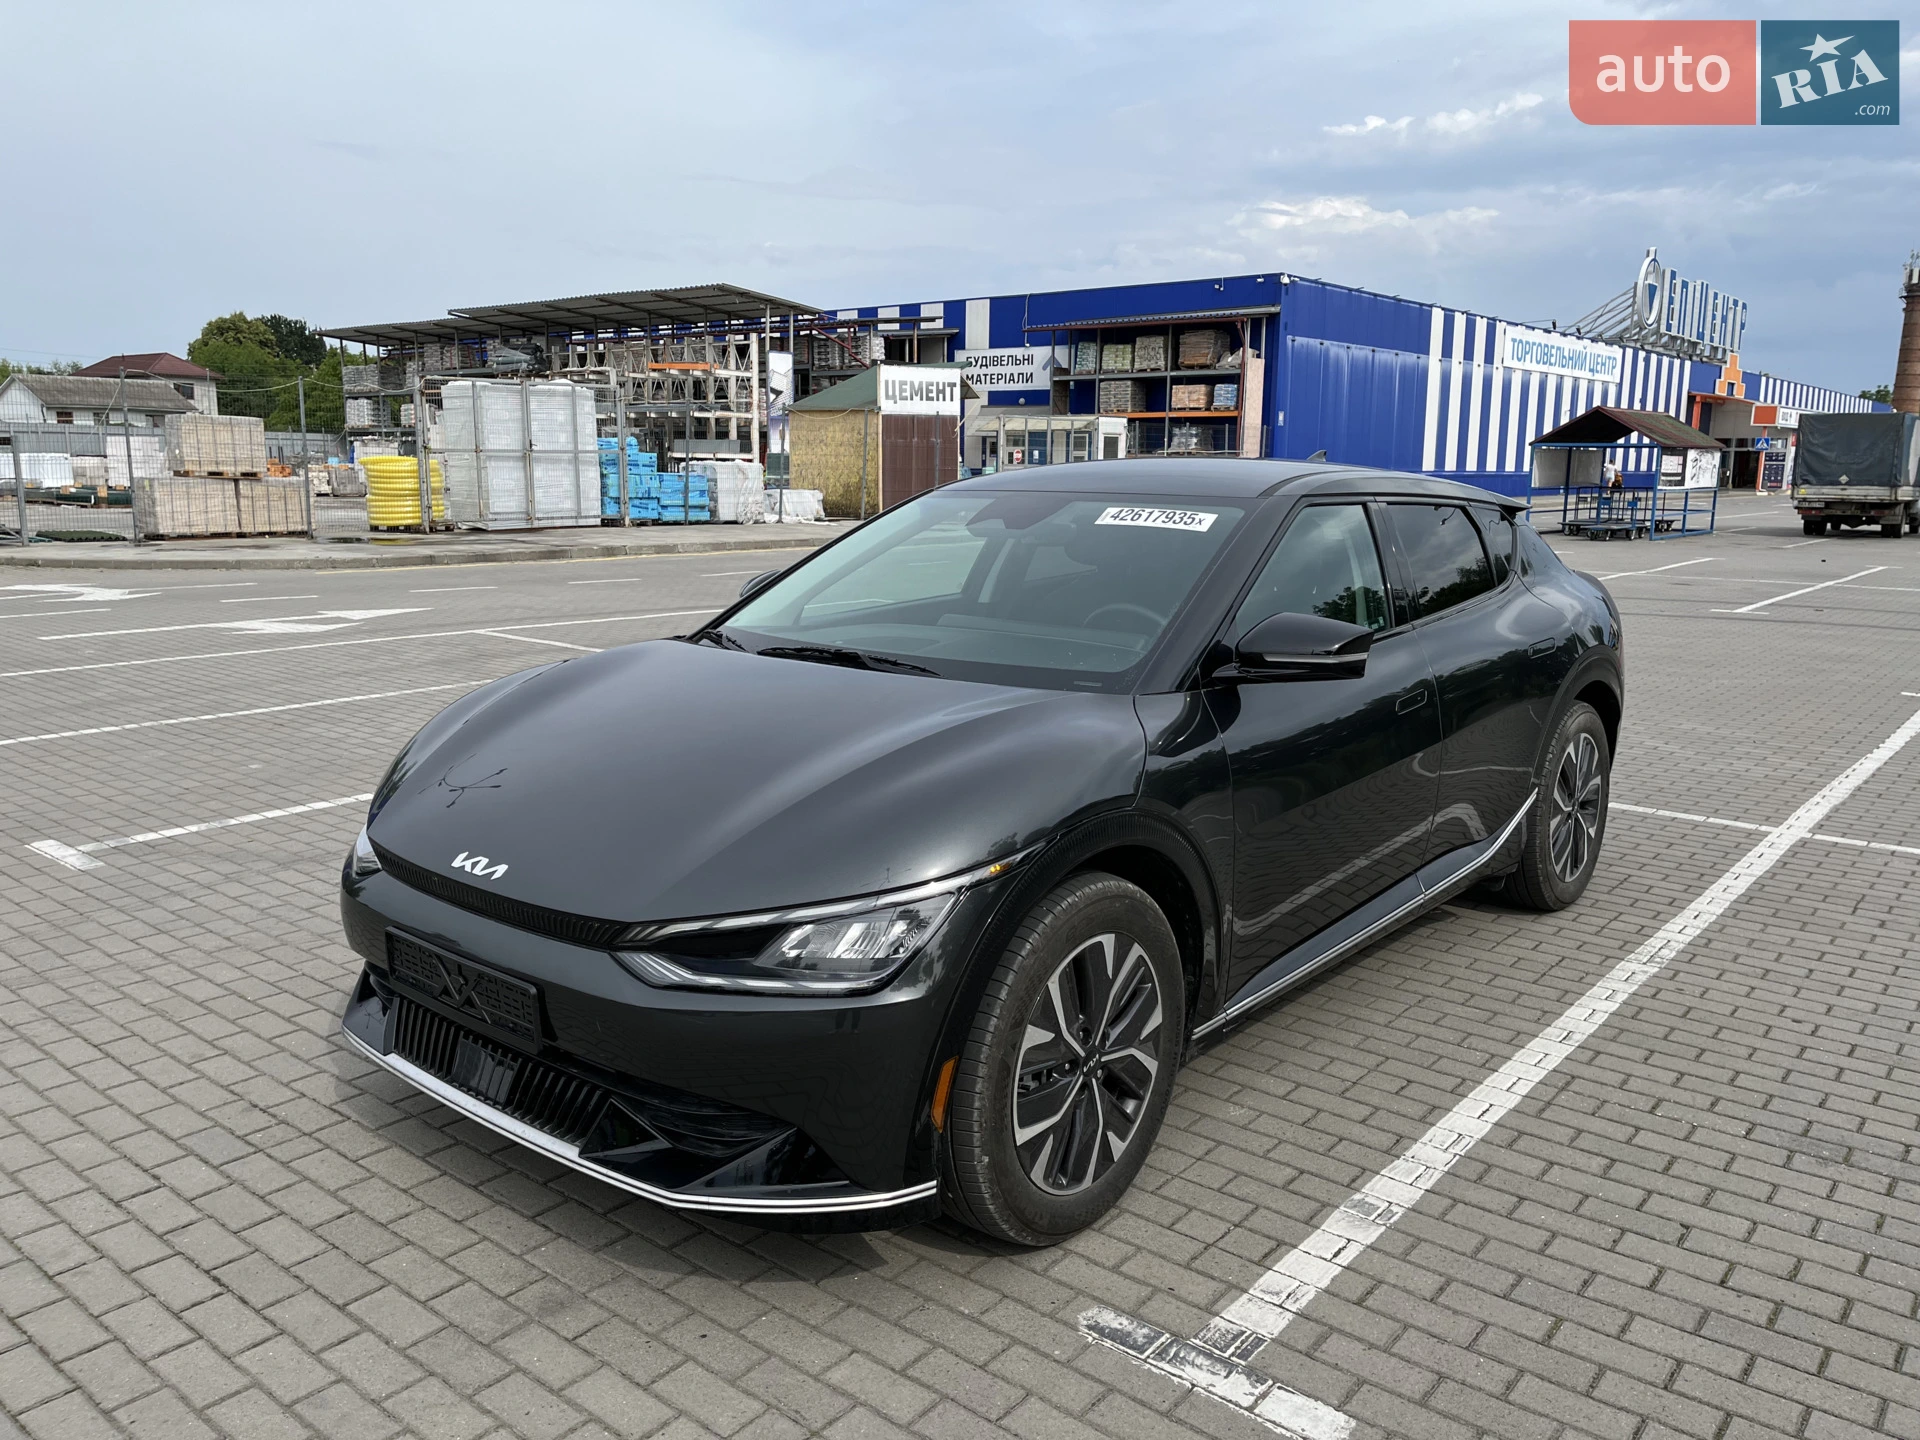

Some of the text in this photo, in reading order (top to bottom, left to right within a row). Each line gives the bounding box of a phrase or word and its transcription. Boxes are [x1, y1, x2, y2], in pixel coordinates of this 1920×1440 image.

[966, 354, 1034, 369] БУДІВЕЛЬНІ
[1510, 337, 1618, 377] ТОРГОВЕЛЬНИЙ ЦЕНТР
[966, 372, 1034, 386] МАТЕРІАЛИ
[884, 379, 957, 404] ЦЕМЕНТ
